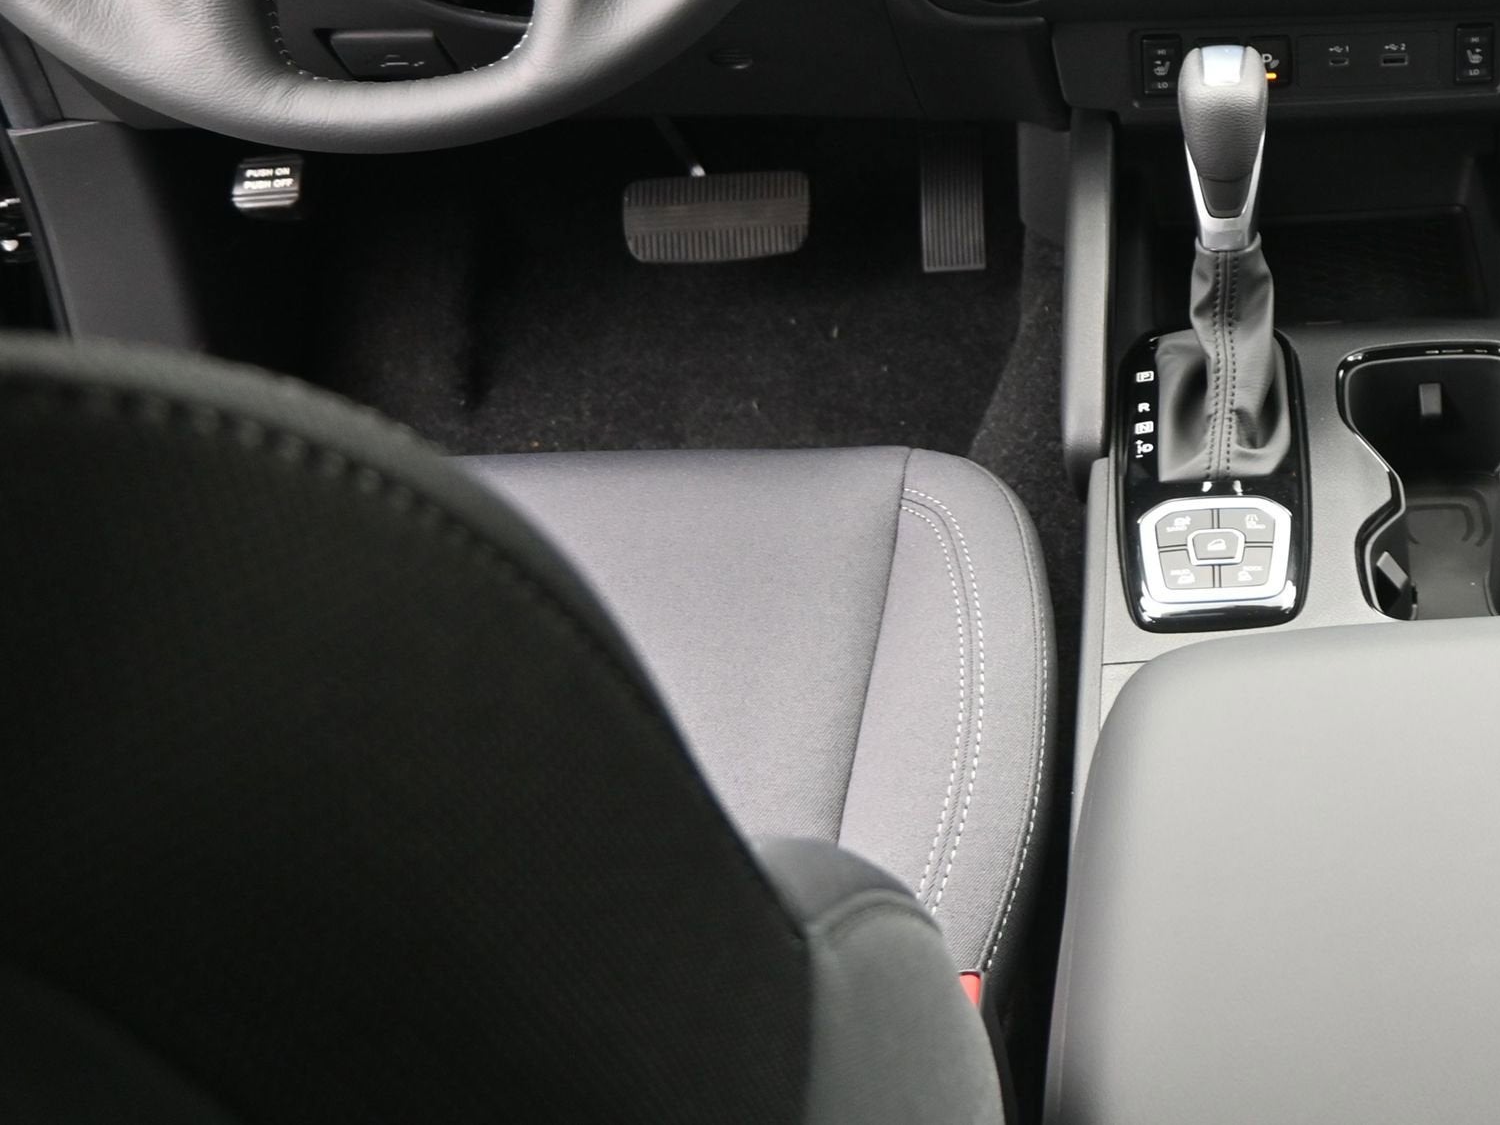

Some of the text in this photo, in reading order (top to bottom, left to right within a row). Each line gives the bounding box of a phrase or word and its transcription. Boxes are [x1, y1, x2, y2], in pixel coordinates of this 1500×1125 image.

[245, 167, 290, 178] PUSH ON
[243, 178, 294, 190] PUSH OFF
[1138, 402, 1150, 413] R
